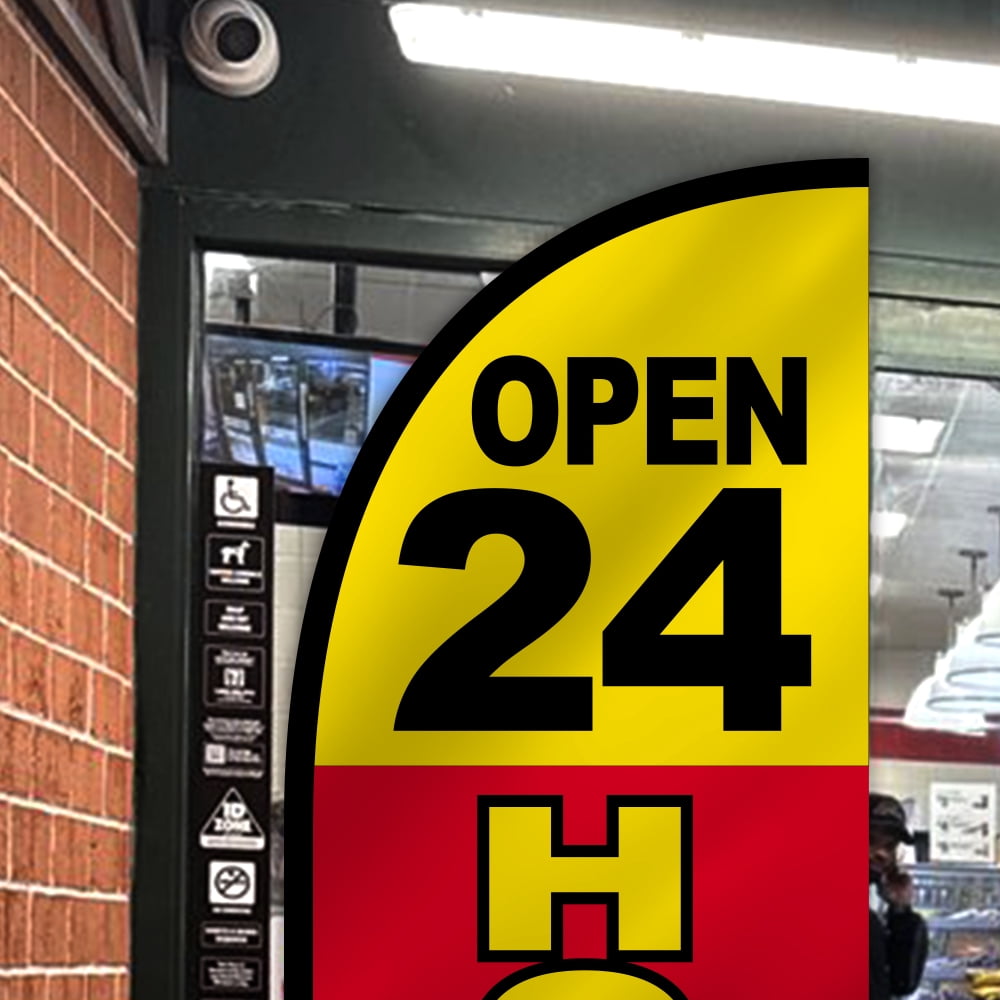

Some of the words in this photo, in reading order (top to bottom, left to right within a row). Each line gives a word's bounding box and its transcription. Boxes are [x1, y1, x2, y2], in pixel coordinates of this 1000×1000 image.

[471, 356, 807, 467] OPEN
[394, 487, 812, 732] 24
[223, 803, 247, 819] ID
